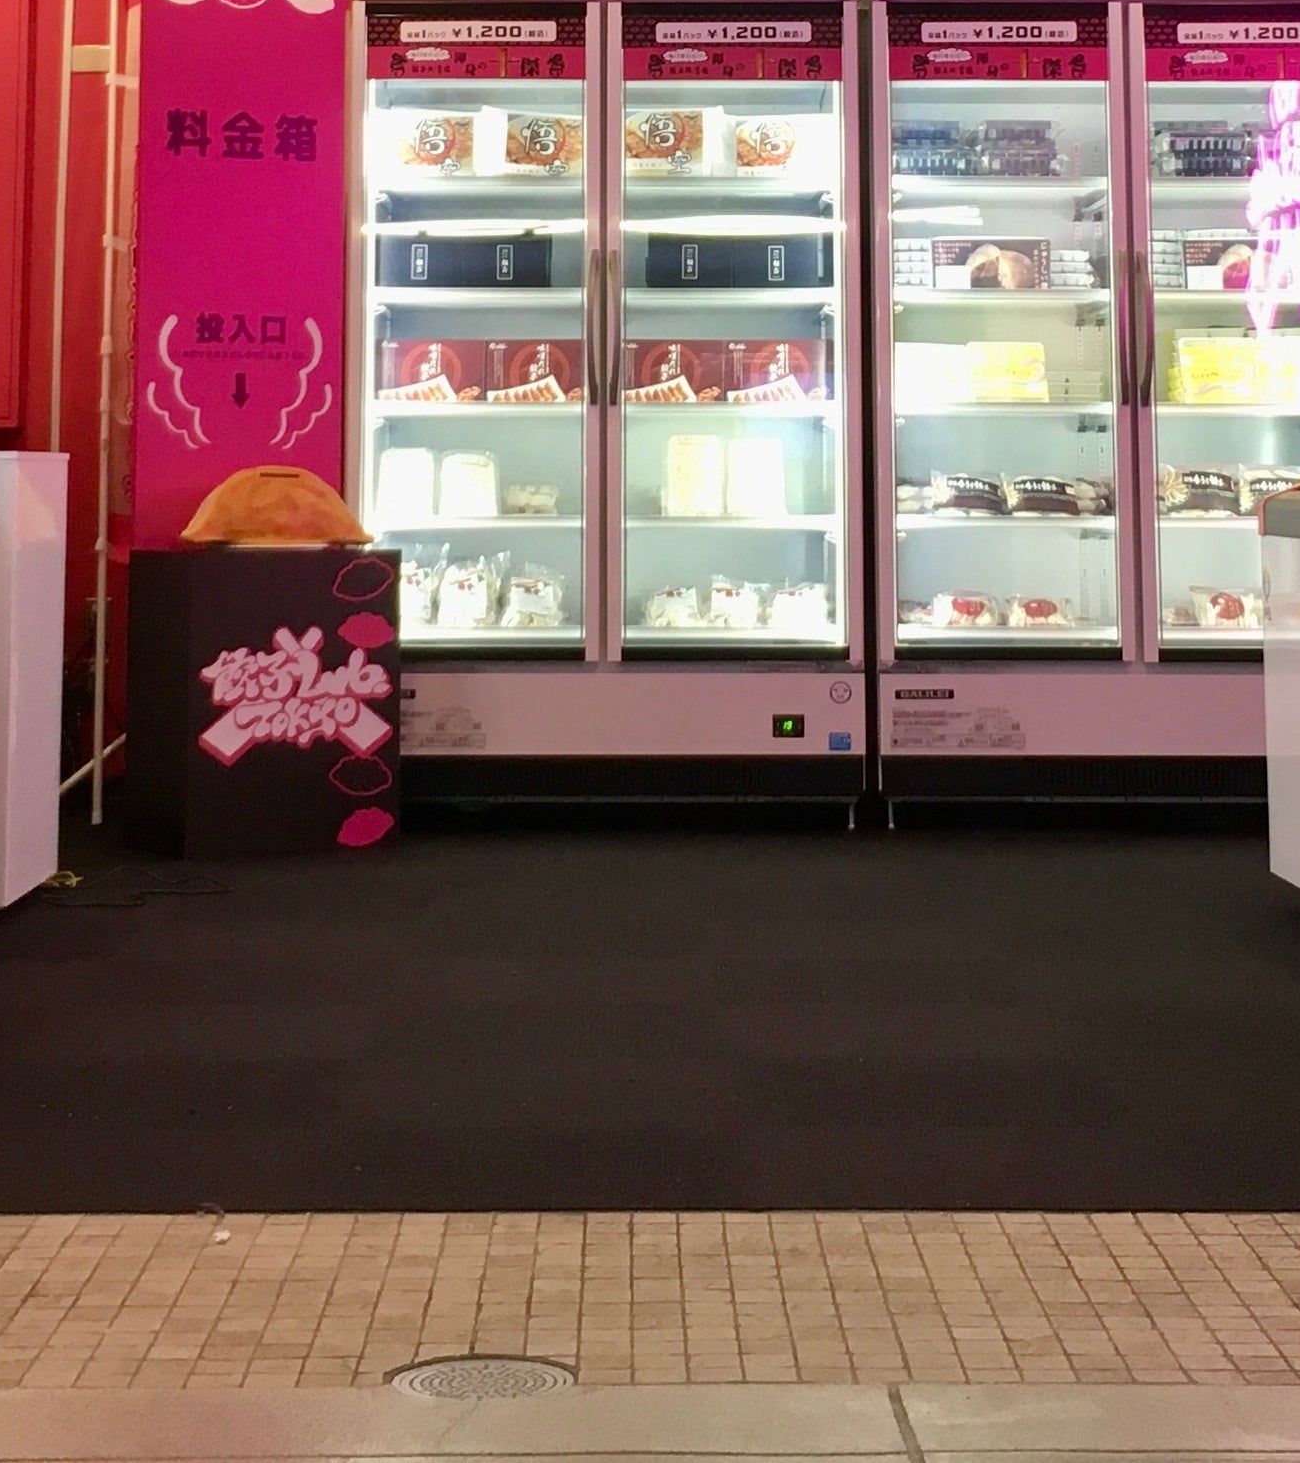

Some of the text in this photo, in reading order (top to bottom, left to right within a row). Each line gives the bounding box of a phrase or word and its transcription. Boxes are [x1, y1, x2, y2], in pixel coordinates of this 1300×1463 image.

[166, 108, 318, 162] 料金箱
[196, 312, 286, 344] 投入口
